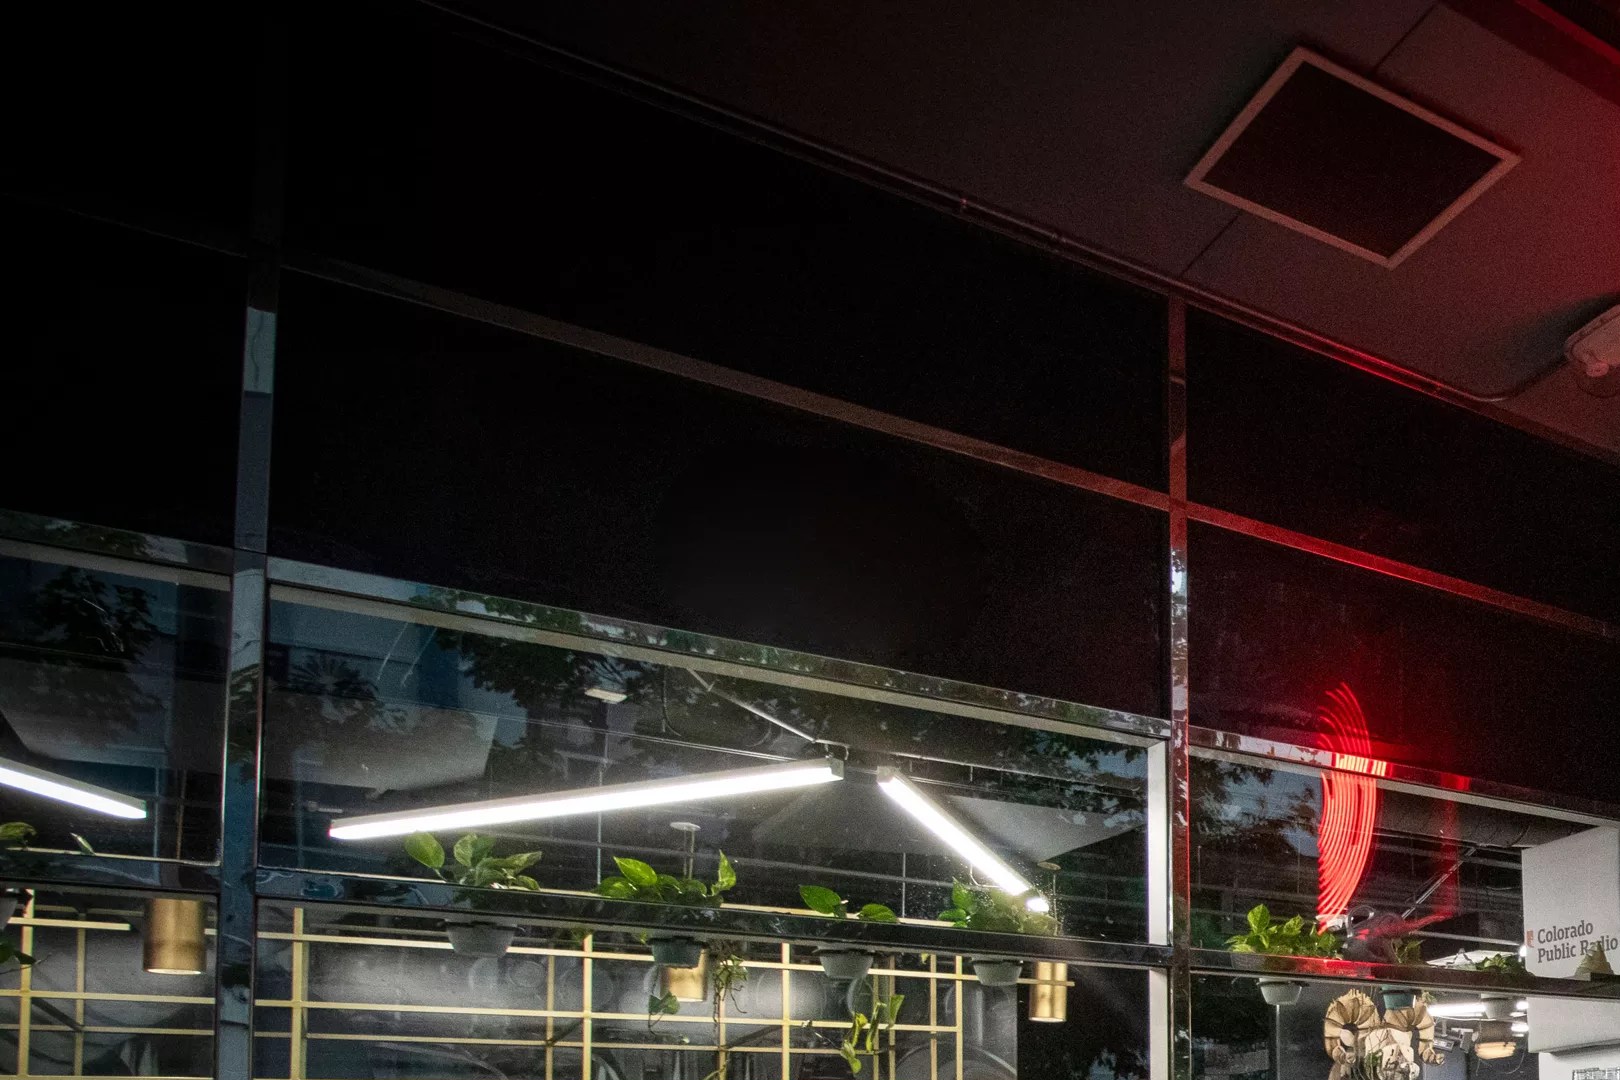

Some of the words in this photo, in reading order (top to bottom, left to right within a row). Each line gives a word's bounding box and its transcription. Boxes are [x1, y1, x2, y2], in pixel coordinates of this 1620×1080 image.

[1537, 919, 1594, 944] Colorado
[1537, 943, 1577, 964] Public
[1580, 935, 1619, 956] Rdio
